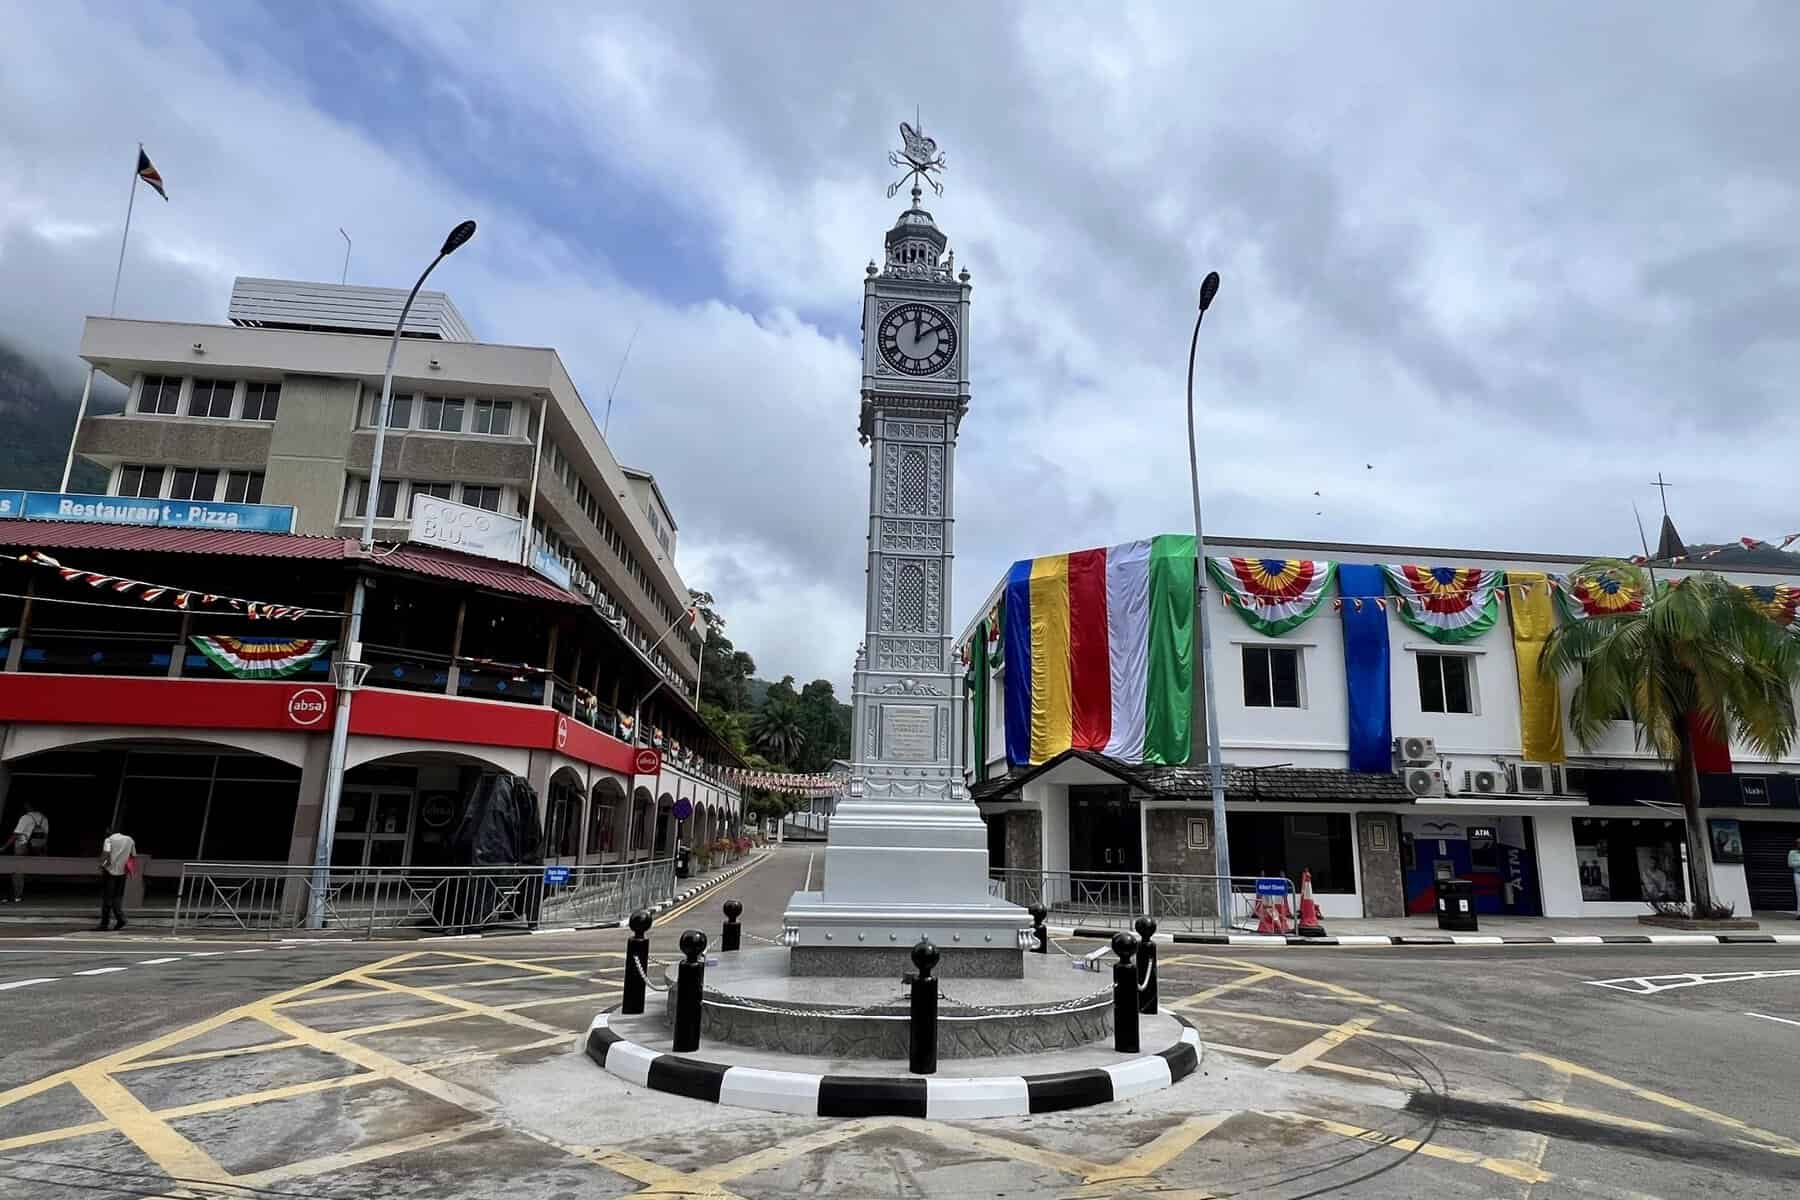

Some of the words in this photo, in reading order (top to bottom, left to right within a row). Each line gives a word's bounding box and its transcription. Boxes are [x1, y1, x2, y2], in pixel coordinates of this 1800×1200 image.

[60, 500, 171, 522] Restaurant
[188, 506, 238, 526] Pizza
[294, 699, 322, 711] absa
[1475, 829, 1490, 837] ATM
[1508, 849, 1524, 890] ATM
